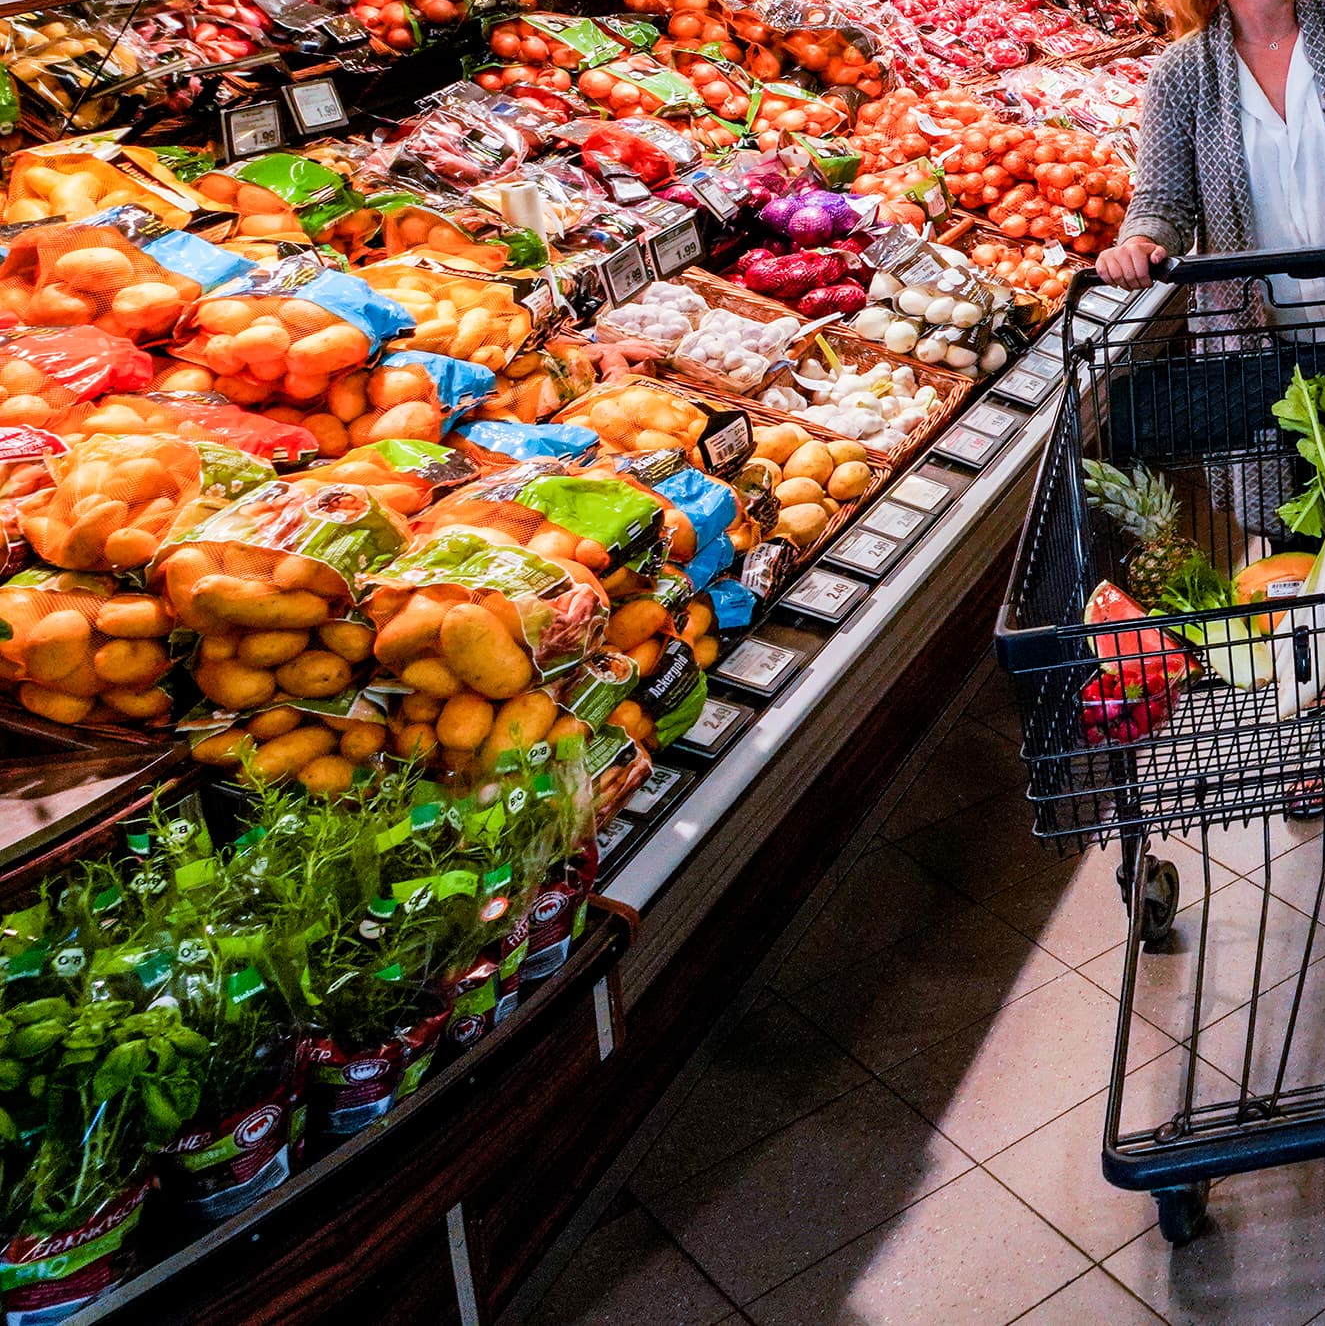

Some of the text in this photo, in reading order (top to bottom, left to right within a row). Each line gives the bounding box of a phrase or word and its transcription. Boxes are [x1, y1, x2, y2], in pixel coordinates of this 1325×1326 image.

[316, 104, 337, 118] 1.99
[252, 130, 275, 145] 1.99
[676, 241, 697, 260] 1.99
[868, 540, 890, 558] 2.99
[826, 583, 849, 600] 2.49
[759, 652, 786, 671] 2.49
[648, 653, 689, 698] Ackergold
[703, 707, 732, 730] 2.49
[640, 771, 671, 795] 2.49
